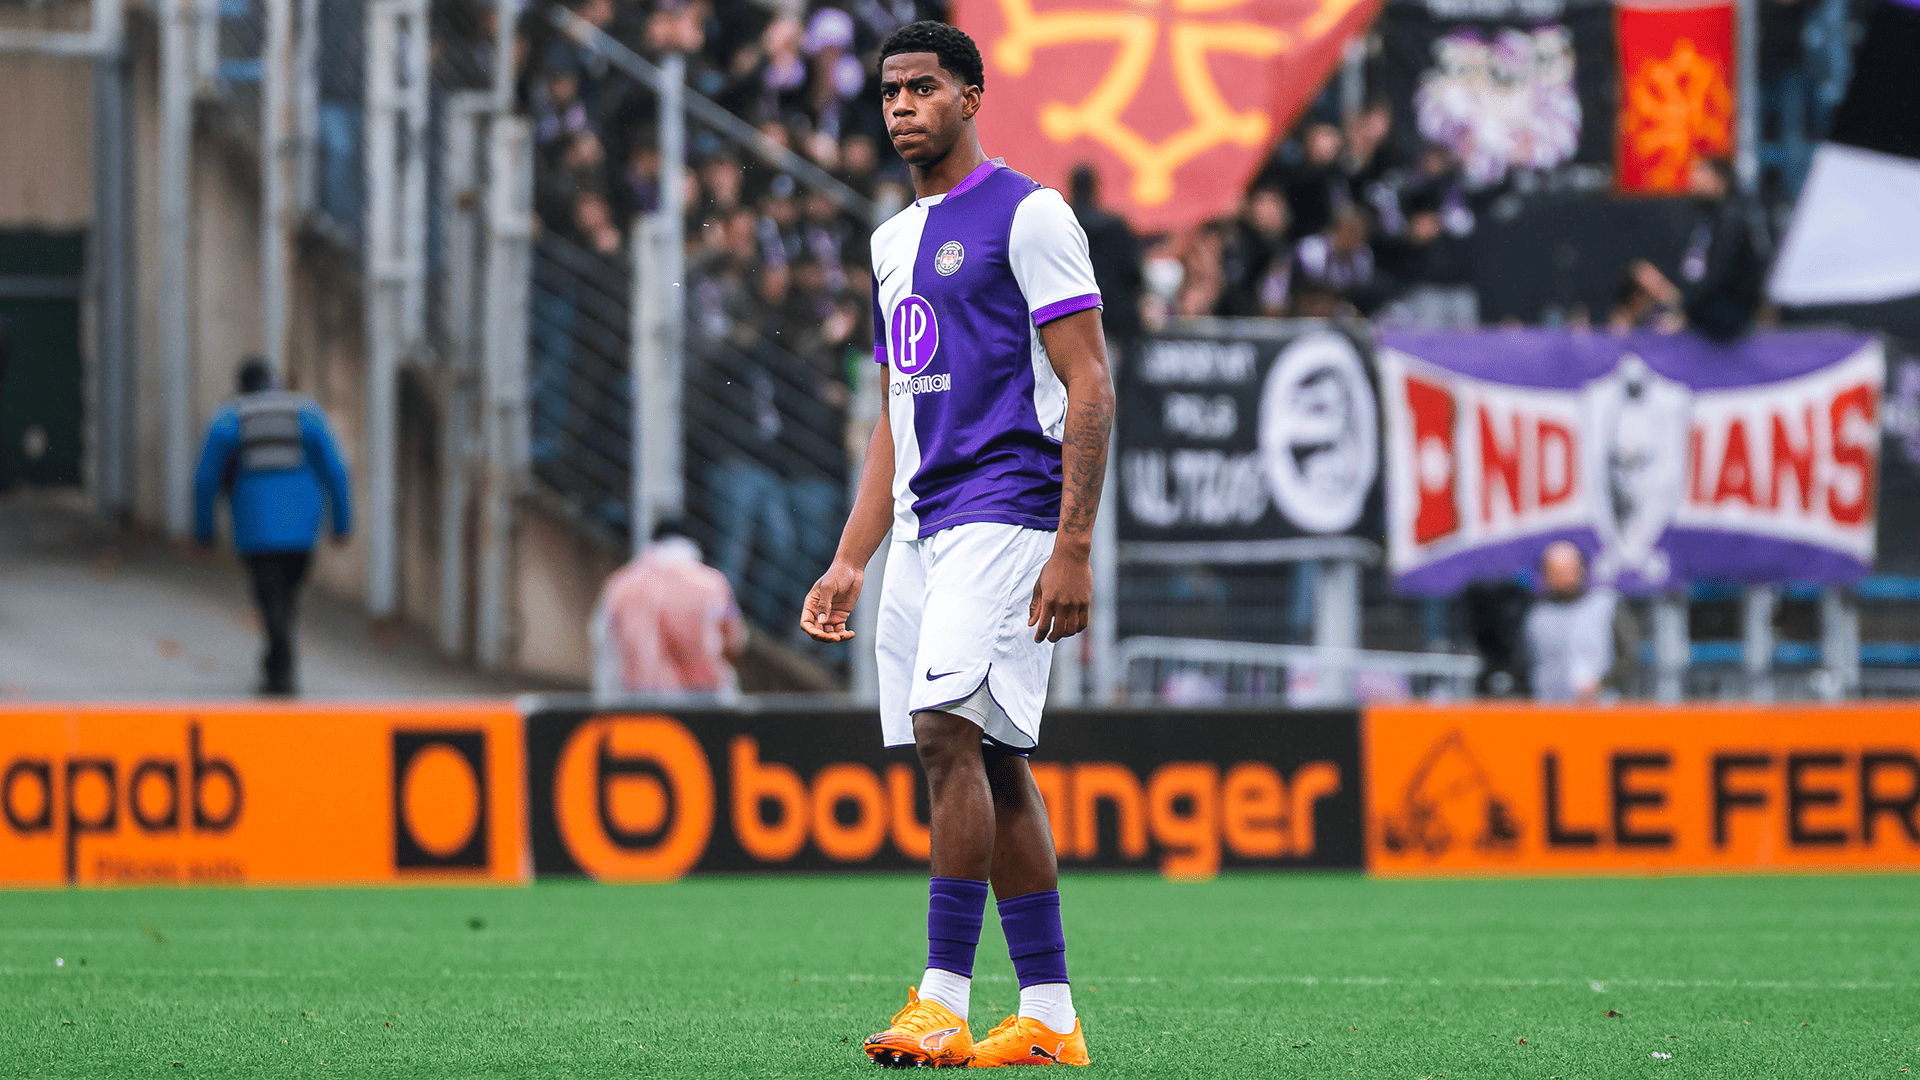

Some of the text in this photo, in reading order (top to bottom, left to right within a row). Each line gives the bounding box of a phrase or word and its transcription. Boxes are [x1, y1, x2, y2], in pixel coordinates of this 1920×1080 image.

[901, 303, 928, 368] LP
[1, 718, 246, 886] apab
[1542, 747, 1920, 849] LE FER
